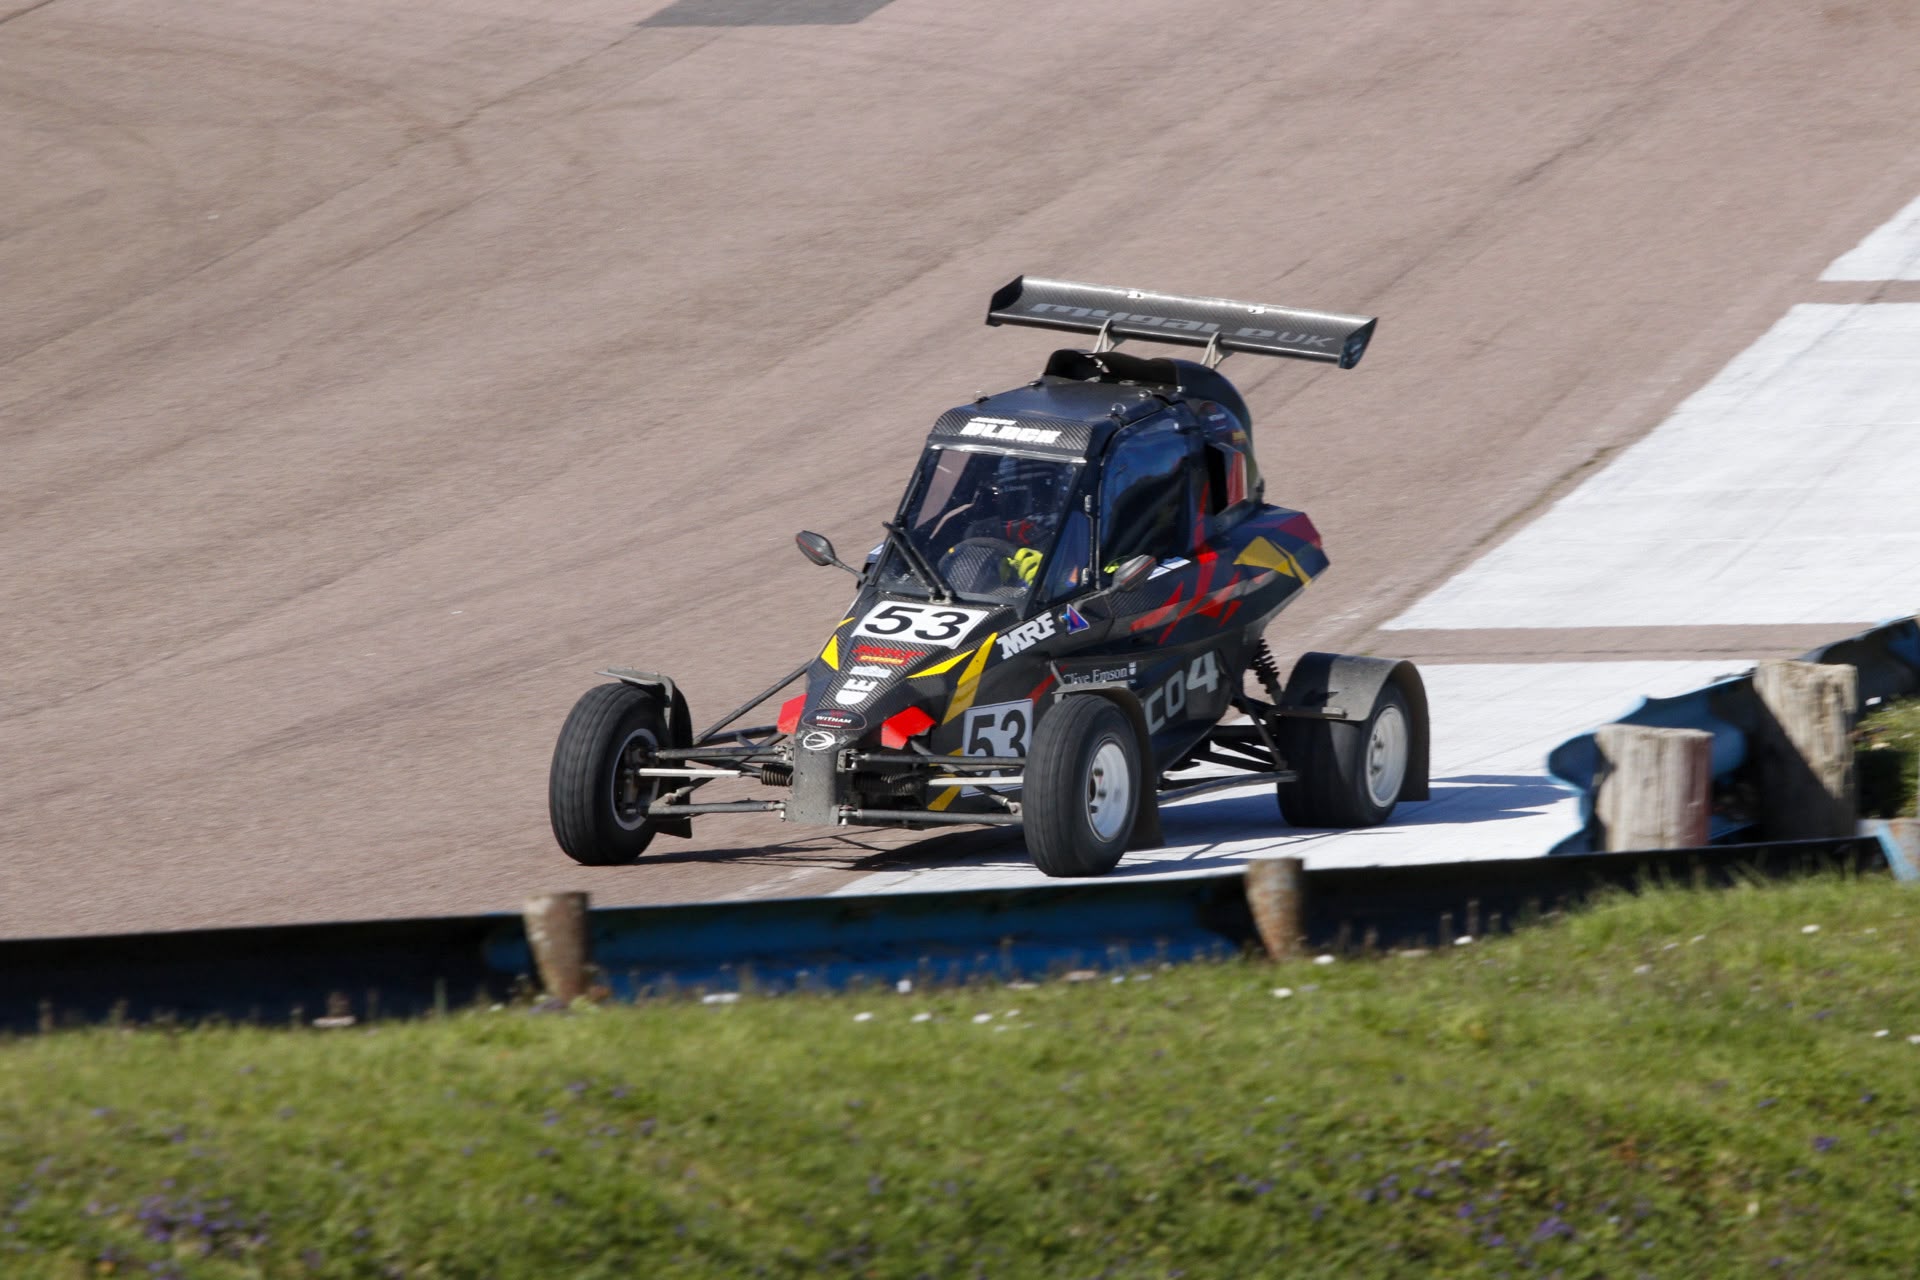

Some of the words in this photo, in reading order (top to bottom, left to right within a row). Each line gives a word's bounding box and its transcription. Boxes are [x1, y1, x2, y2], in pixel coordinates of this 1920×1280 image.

[864, 605, 970, 640] 53
[996, 612, 1056, 660] MRF
[1092, 667, 1128, 684] Emson
[815, 715, 852, 724] WITHAM
[968, 709, 1026, 777] 53
